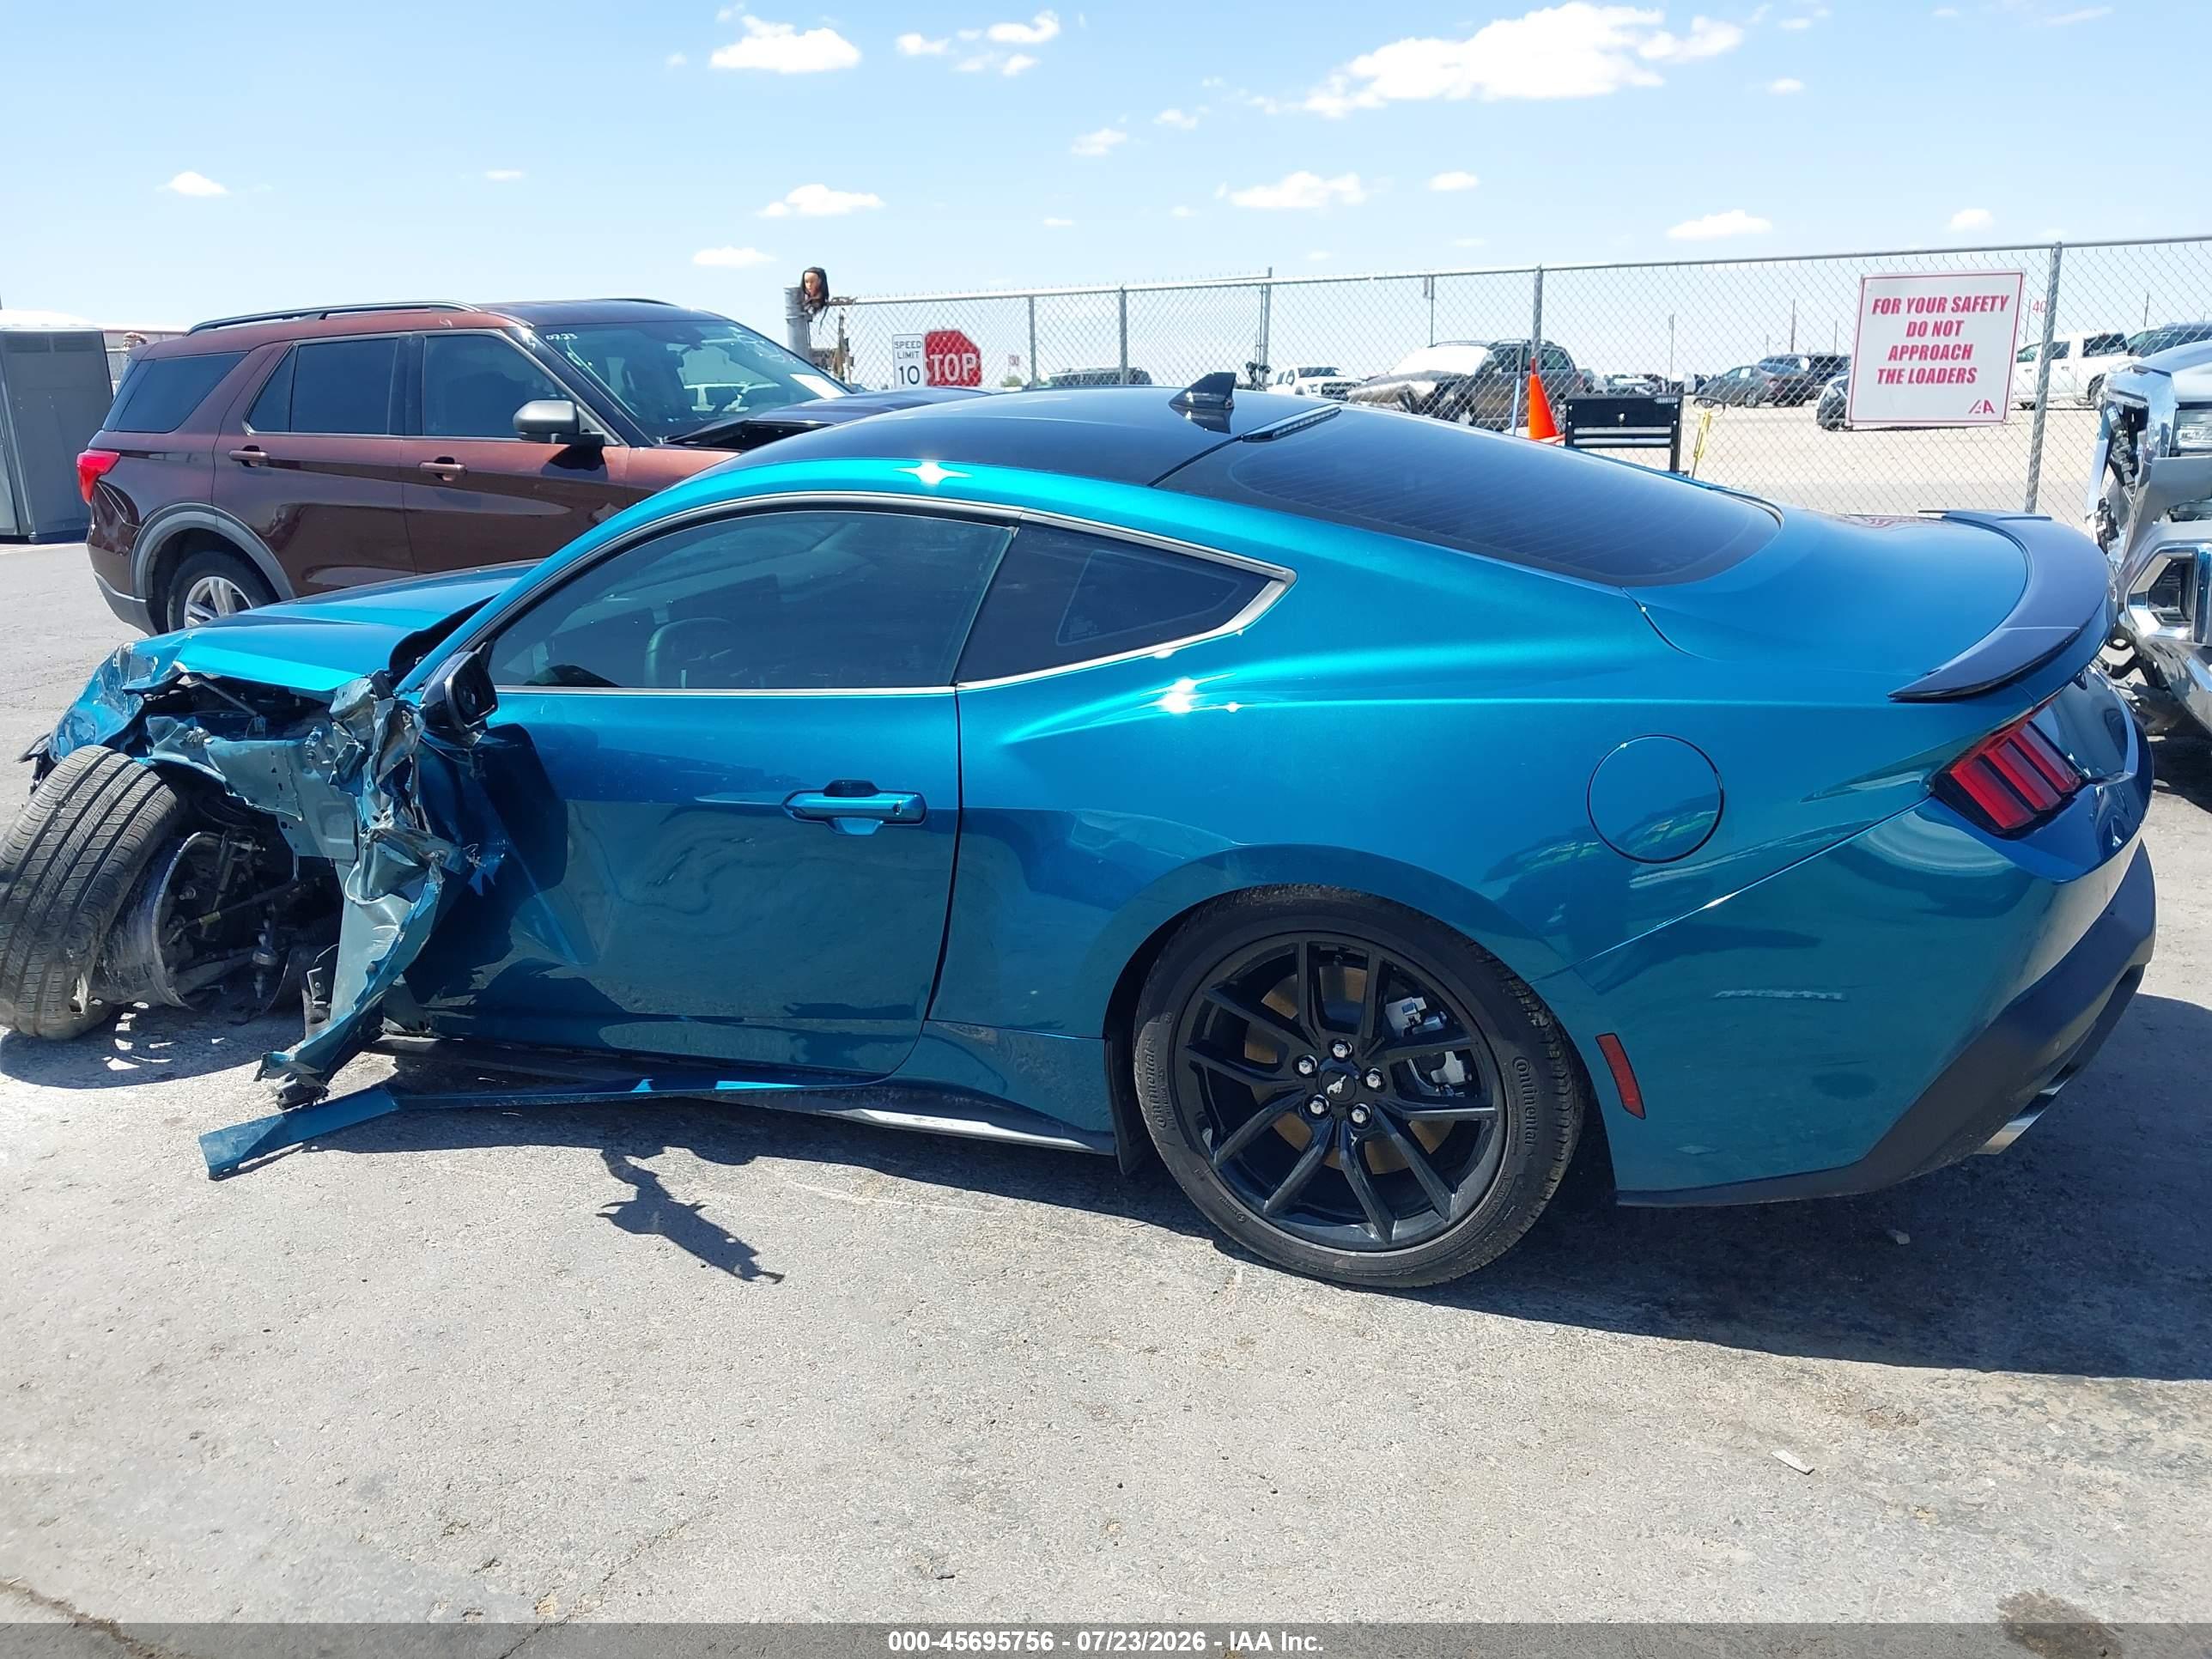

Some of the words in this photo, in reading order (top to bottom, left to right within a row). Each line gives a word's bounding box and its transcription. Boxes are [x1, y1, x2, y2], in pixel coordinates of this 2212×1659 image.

[1872, 298, 1901, 314] FOR
[1906, 296, 1948, 313] YOUR
[1951, 295, 2009, 313] SAFETY
[1905, 320, 1929, 337] DO
[1931, 319, 1965, 337] NOT
[894, 340, 921, 349] SPEED
[1887, 343, 1973, 361] APPROACH
[896, 350, 920, 359] LIMIT
[898, 365, 920, 385] 10
[926, 352, 976, 381] TOP
[1877, 368, 1905, 384] THE
[1907, 368, 1978, 384] LOADERS
[1144, 1048, 1168, 1129] Continental
[1512, 1056, 1538, 1146] Continental
